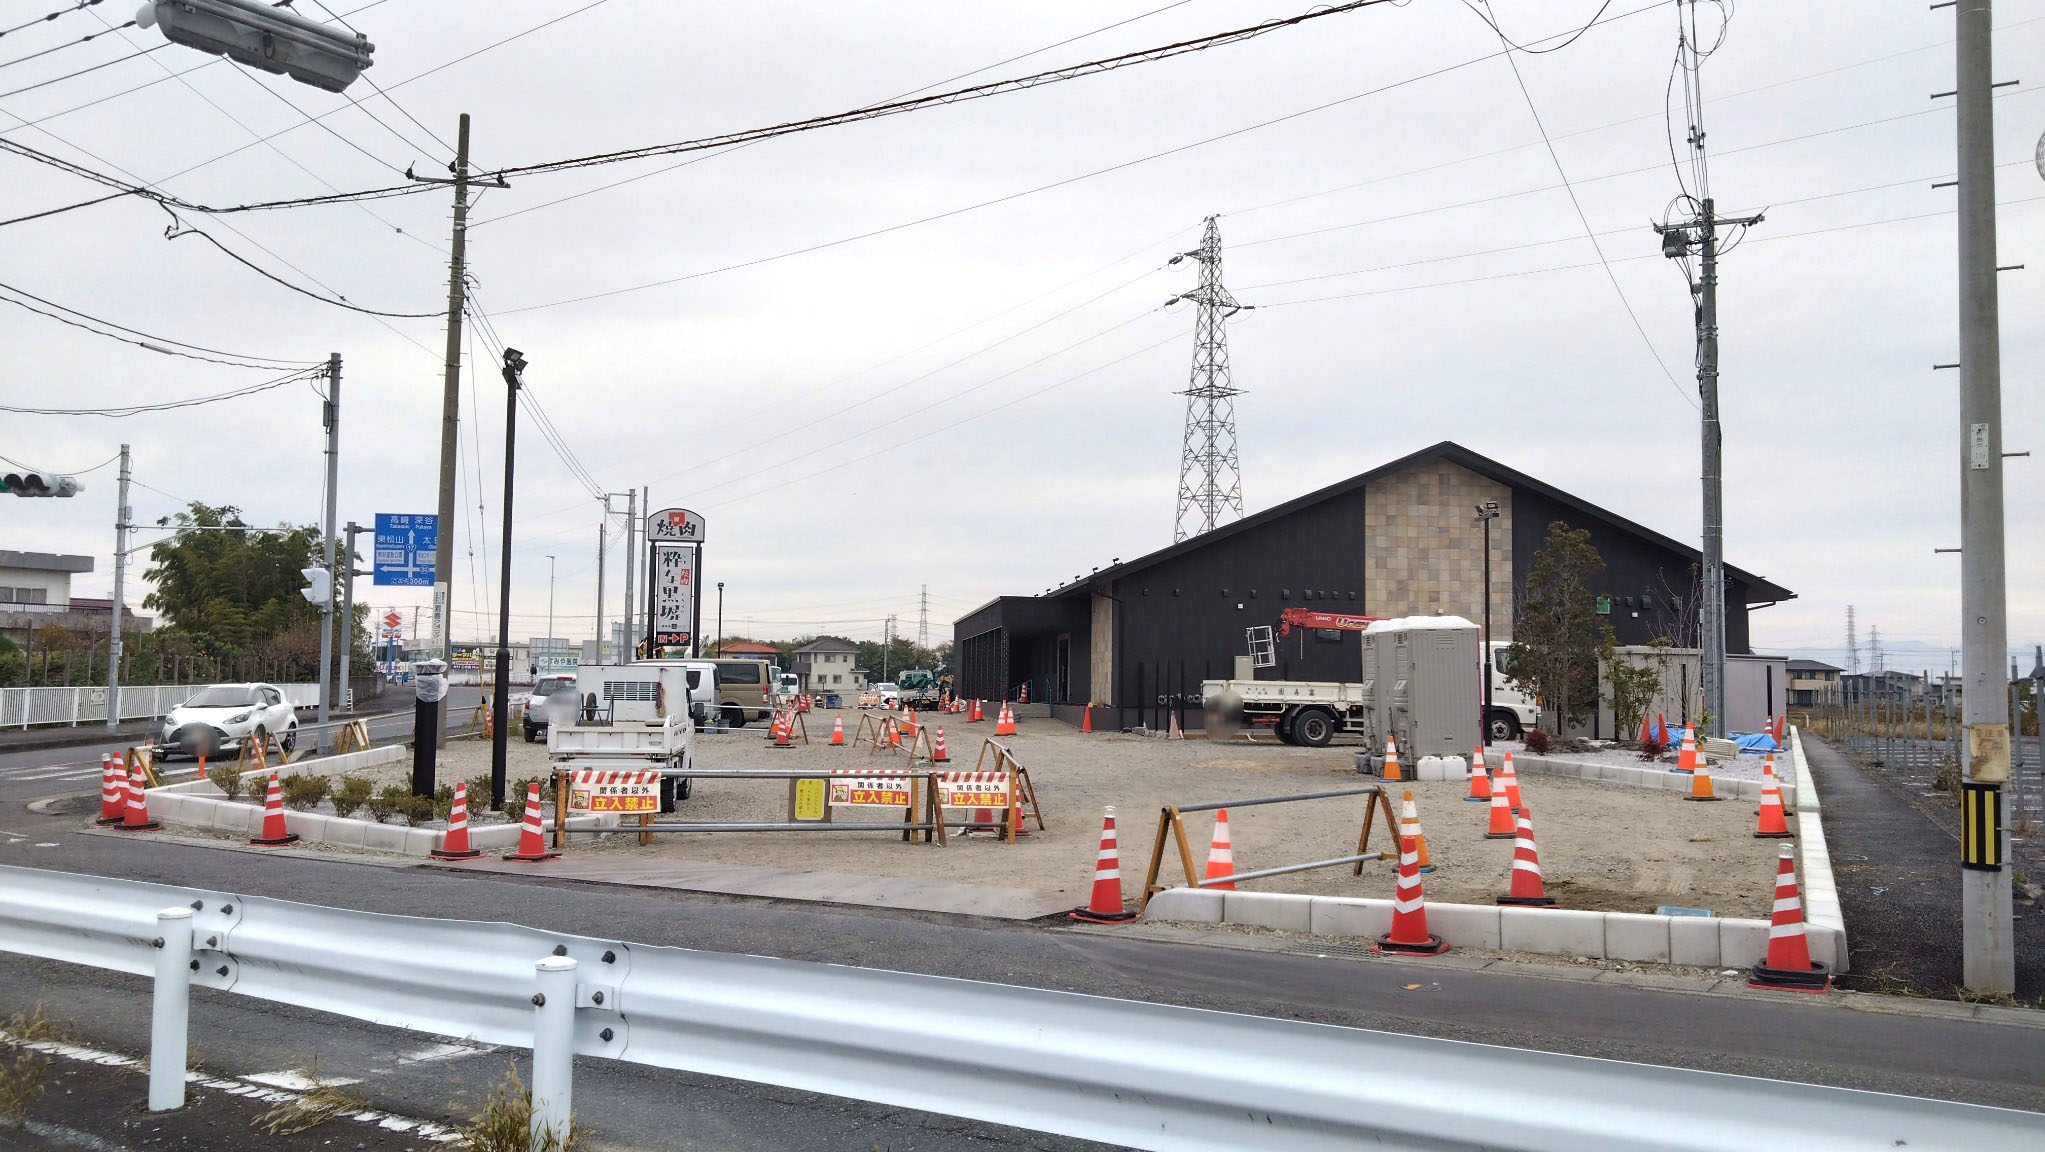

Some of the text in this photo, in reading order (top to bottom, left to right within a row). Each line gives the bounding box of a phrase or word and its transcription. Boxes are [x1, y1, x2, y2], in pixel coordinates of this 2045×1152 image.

[414, 516, 434, 525] 深谷
[656, 519, 697, 537] 焼肉
[377, 534, 404, 544] 東松山
[657, 633, 689, 643] IN P
[599, 786, 650, 795] 関係者以外
[857, 781, 903, 790] 関係者以外
[956, 784, 1001, 792] 関係者以外
[852, 791, 907, 804] 立入禁止
[953, 793, 1005, 806] 立入禁止
[593, 796, 655, 810] 立入禁止
